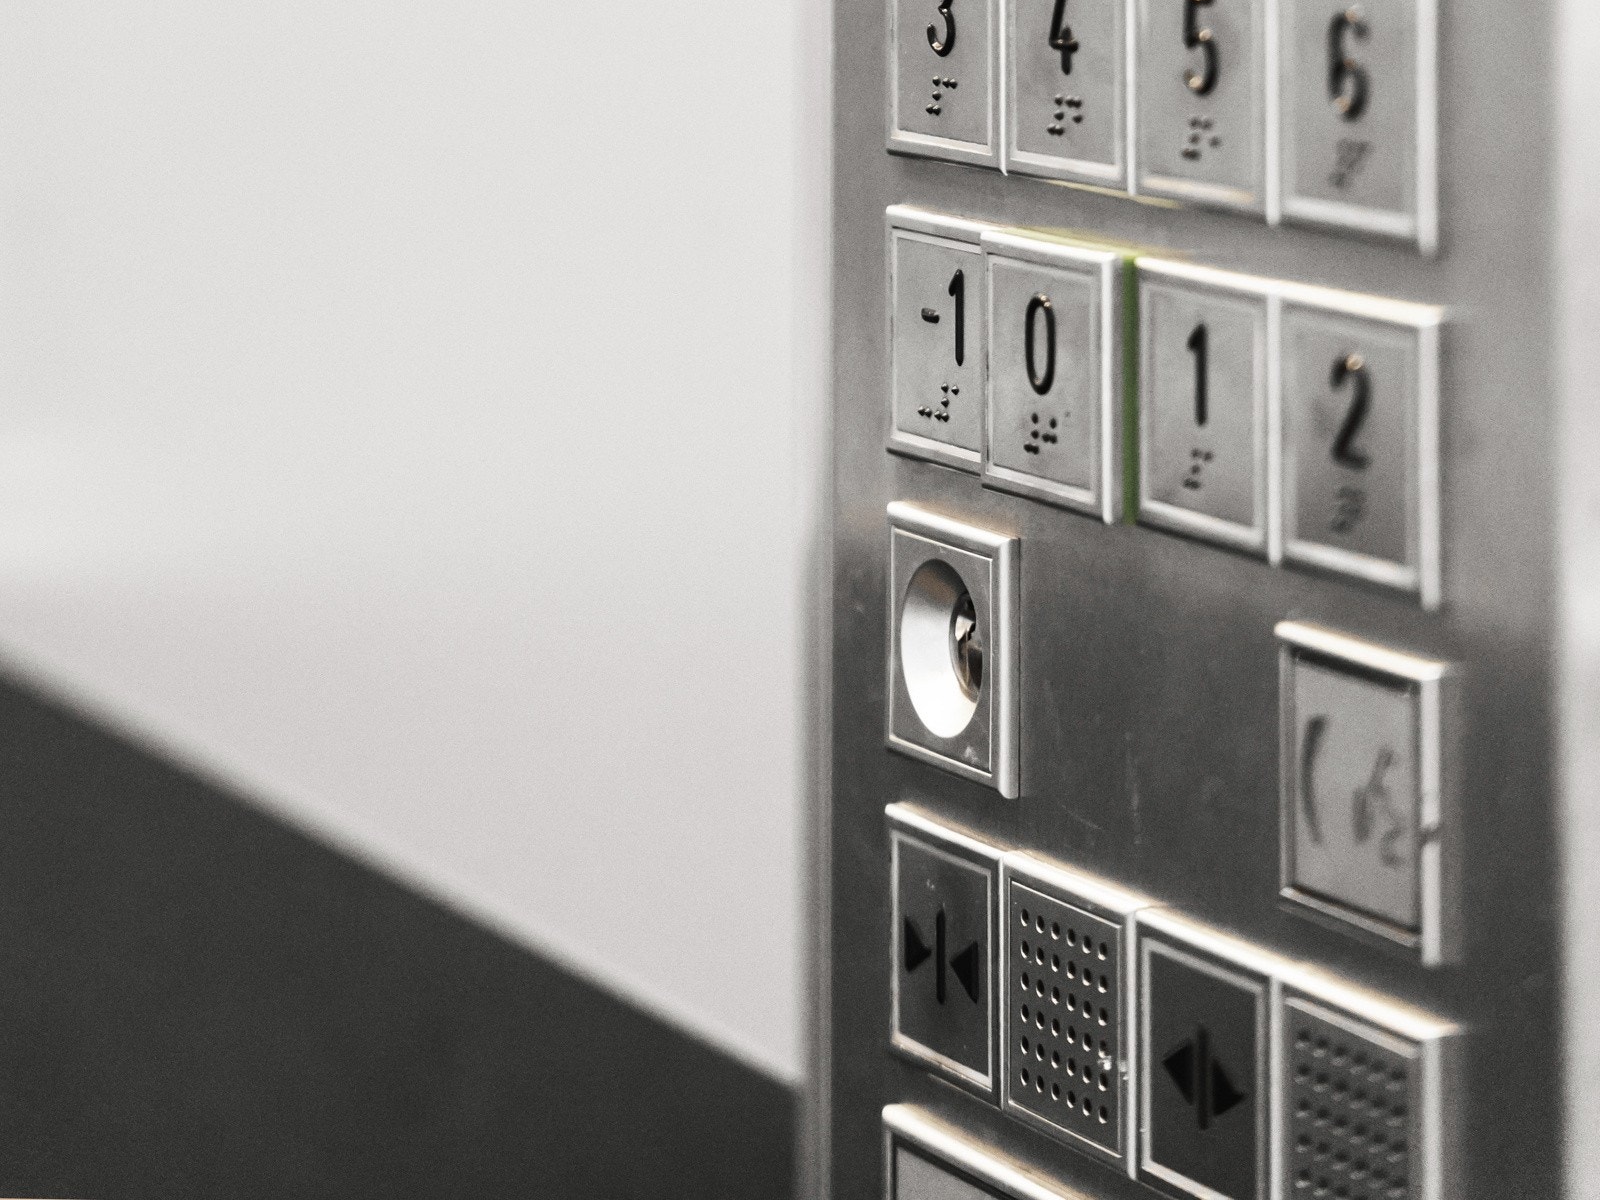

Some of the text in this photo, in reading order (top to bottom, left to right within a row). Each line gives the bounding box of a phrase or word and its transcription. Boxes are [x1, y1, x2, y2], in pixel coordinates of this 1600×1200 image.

[1327, 5, 1370, 121] 6
[921, 268, 965, 367] -1
[1024, 293, 1056, 395] 0
[1187, 323, 1209, 426] 1
[1328, 353, 1371, 469] 2
